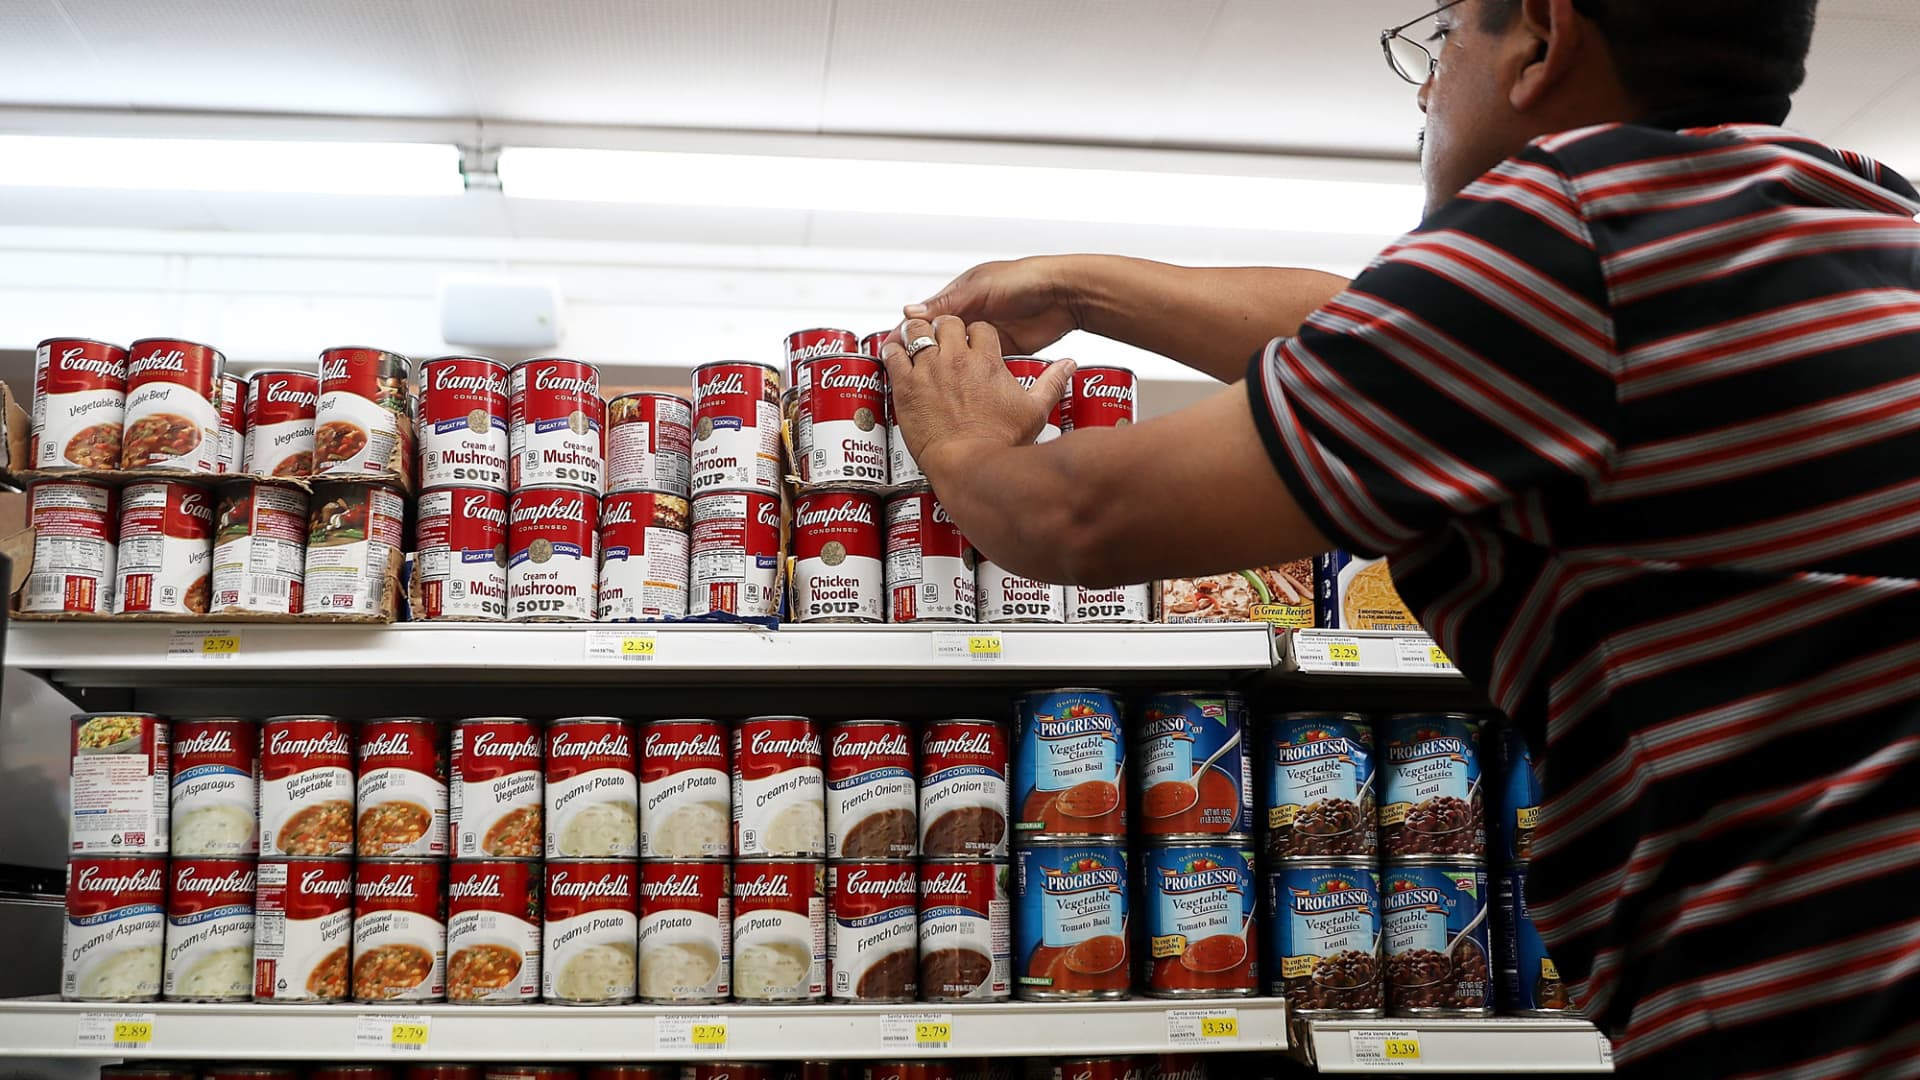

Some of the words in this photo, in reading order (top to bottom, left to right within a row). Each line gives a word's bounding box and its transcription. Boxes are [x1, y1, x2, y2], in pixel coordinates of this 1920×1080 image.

[150, 388, 171, 401] Beef
[69, 400, 113, 417] Vegetable
[461, 440, 487, 450] Cream
[488, 440, 496, 451] of
[562, 440, 587, 451] Cream
[710, 446, 719, 456] of
[842, 438, 884, 455] Chicken
[442, 449, 508, 470] Mushroom
[844, 451, 884, 467] Noodle
[453, 467, 501, 483] SOUP
[555, 467, 598, 484] SOUP
[843, 464, 885, 481] SOUP
[509, 497, 586, 525] Campbell's
[796, 500, 873, 528] Campbell's
[518, 524, 568, 533] CONDENSED
[808, 527, 859, 536] CONDENSED
[554, 544, 580, 555] COOKING
[522, 571, 547, 582] Cream
[548, 571, 559, 581] of
[809, 575, 860, 588] Chicken
[1001, 577, 1051, 589] Chicken
[452, 582, 463, 591] 90
[510, 580, 578, 598] Mushroom
[810, 587, 859, 601] Noodle
[1003, 590, 1050, 602] Noodle
[1078, 590, 1125, 604] Noodle
[516, 600, 566, 613] SOUP
[809, 602, 860, 616] SOUP
[1002, 603, 1051, 616] SOUP
[1077, 605, 1126, 618] SOUP
[1254, 607, 1260, 615] 6
[1261, 604, 1285, 615] Great
[1285, 606, 1312, 619] Recipes
[624, 641, 654, 651] $2.39
[970, 639, 1000, 649] $2.19
[1330, 648, 1358, 658] $2.29
[1040, 715, 1112, 737] PROGRESSO
[552, 732, 629, 760] Campbell's
[645, 732, 721, 760] Campbell's
[832, 732, 908, 760] Campbell's
[1048, 736, 1104, 756] Vegetable
[1279, 740, 1348, 761] PROGRESSO
[1390, 740, 1461, 761] PROGRESSO
[1069, 748, 1104, 760] Classics
[187, 766, 226, 778] COOKING
[948, 767, 986, 778] COOKING
[1052, 764, 1084, 778] Tomato
[1085, 762, 1103, 773] Basil
[1156, 762, 1174, 774] Basil
[1287, 759, 1341, 780] Vegetable
[1398, 760, 1453, 779] Vegetable
[287, 778, 298, 790] Old
[300, 771, 335, 785] Fashioned
[836, 777, 860, 790] GREAT
[870, 768, 905, 780] COOKING
[1305, 771, 1341, 783] Classics
[1417, 770, 1453, 783] Classics
[184, 779, 236, 797] Asparagus
[288, 780, 333, 801] Vegetable
[493, 780, 507, 793] Old
[495, 782, 536, 803] Vegetable
[555, 786, 585, 811] Cream
[585, 781, 594, 793] of
[594, 775, 625, 788] Potato
[648, 785, 677, 811] Cream
[677, 781, 686, 793] of
[687, 776, 717, 789] Potato
[756, 783, 790, 808] Cream
[789, 779, 798, 791] of
[951, 780, 982, 794] Onion
[1303, 786, 1328, 798] Lentil
[1415, 784, 1440, 796] Lentil
[841, 789, 873, 814] French
[874, 780, 903, 797] Onion
[78, 866, 162, 896] Campbell's
[551, 872, 629, 901] Campbell's
[1048, 869, 1118, 891] PROGRESSO
[1165, 869, 1236, 891] PROGRESSO
[1056, 890, 1111, 910] Vegetable
[1172, 890, 1229, 911] Vegetable
[1296, 889, 1368, 911] PROGRESSO
[927, 908, 962, 919] COOKING
[1077, 903, 1111, 915] Classics
[1192, 902, 1229, 915] Classics
[80, 913, 107, 925] GREAT
[177, 913, 203, 925] GREAT
[320, 918, 331, 931] Old
[660, 916, 693, 931] Potato
[750, 917, 782, 931] Potato
[851, 916, 878, 928] GREAT
[1060, 919, 1092, 933] Tomato
[1093, 917, 1111, 928] Basil
[1176, 919, 1208, 932] Tomato
[1208, 915, 1228, 927] Basil
[1305, 911, 1361, 931] Vegetable
[552, 925, 583, 951] Cream
[583, 920, 592, 933] of
[592, 916, 624, 931] Potato
[931, 921, 958, 937] Onion
[1326, 923, 1361, 935] Classics
[1394, 921, 1428, 934] Classics
[72, 934, 105, 962] Cream
[105, 929, 115, 941] of
[170, 934, 199, 961] Cream
[200, 928, 208, 941] of
[857, 928, 892, 953] French
[1323, 937, 1348, 950] Lentil
[1391, 936, 1414, 949] Lentil
[694, 1026, 725, 1038] $2.79
[917, 1026, 948, 1037] $2.79
[1203, 1022, 1233, 1034] $3.39
[1387, 1043, 1416, 1055] $3.39
